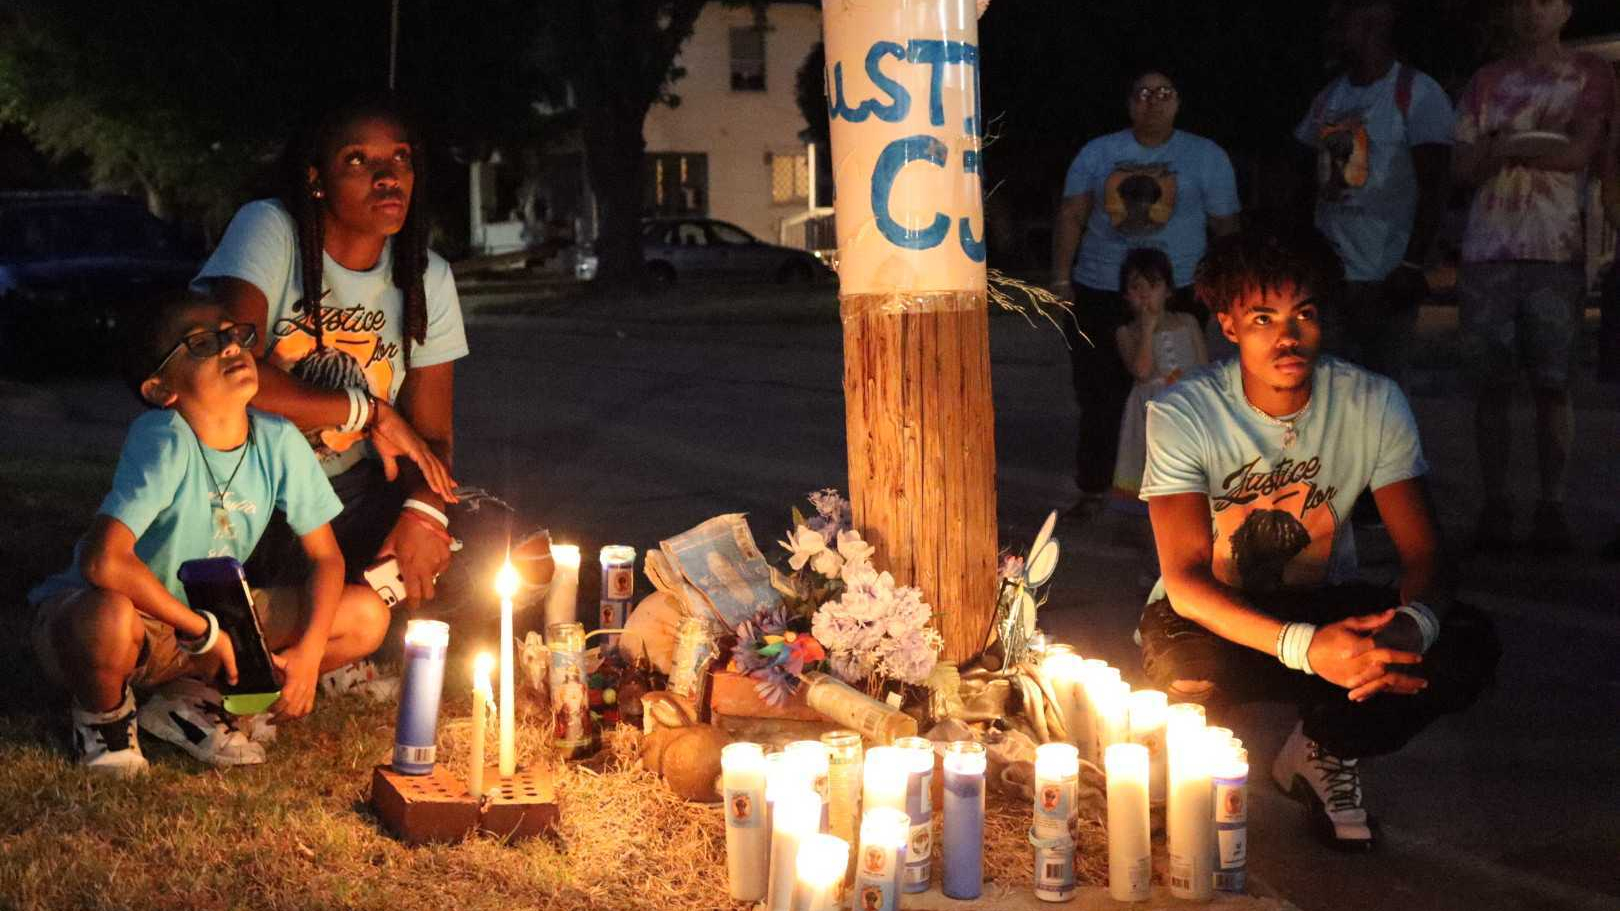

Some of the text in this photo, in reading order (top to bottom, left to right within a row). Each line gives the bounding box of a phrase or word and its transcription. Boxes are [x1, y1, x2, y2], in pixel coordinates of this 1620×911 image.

[364, 336, 398, 368] for
[1212, 456, 1321, 512] Justice
[1300, 483, 1337, 519] for
